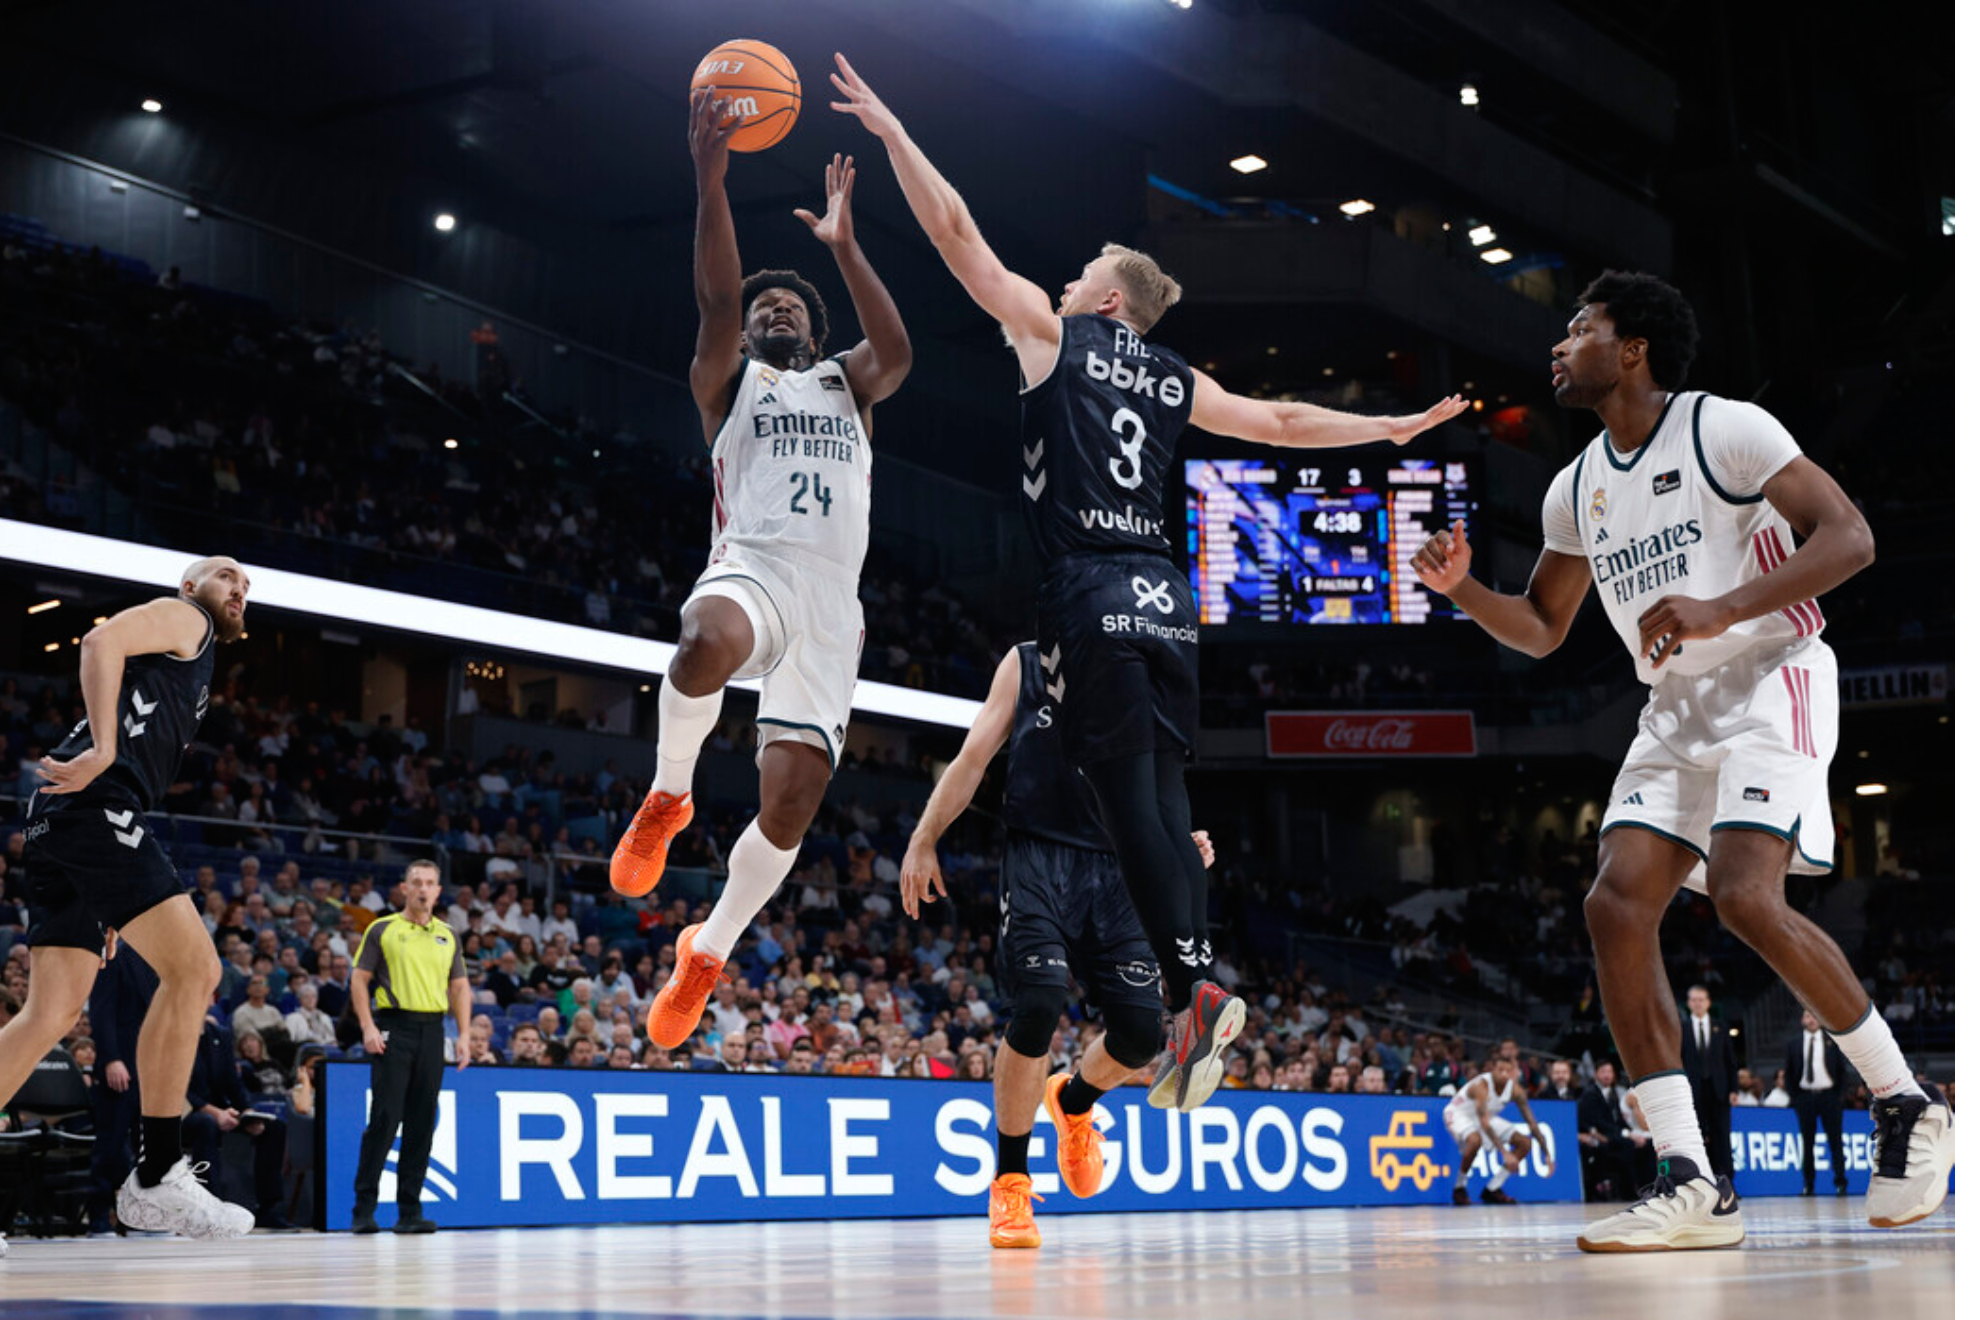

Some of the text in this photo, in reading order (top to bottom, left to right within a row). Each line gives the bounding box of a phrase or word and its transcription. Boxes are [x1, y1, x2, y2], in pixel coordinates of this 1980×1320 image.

[1086, 351, 1156, 398] bbk
[773, 438, 852, 464] FLY BETTER
[1109, 407, 1147, 490] 3
[789, 472, 833, 517] 24
[1297, 468, 1321, 486] 17
[1348, 468, 1362, 487] 3
[1079, 504, 1171, 546] vuelin
[1314, 512, 1362, 533] 4:38
[1593, 519, 1702, 583] Emirates
[1614, 553, 1689, 605] FLY BETTER
[1102, 614, 1198, 644] SR Financial
[496, 1091, 895, 1200] REALE
[1748, 1132, 1830, 1171] REAE
